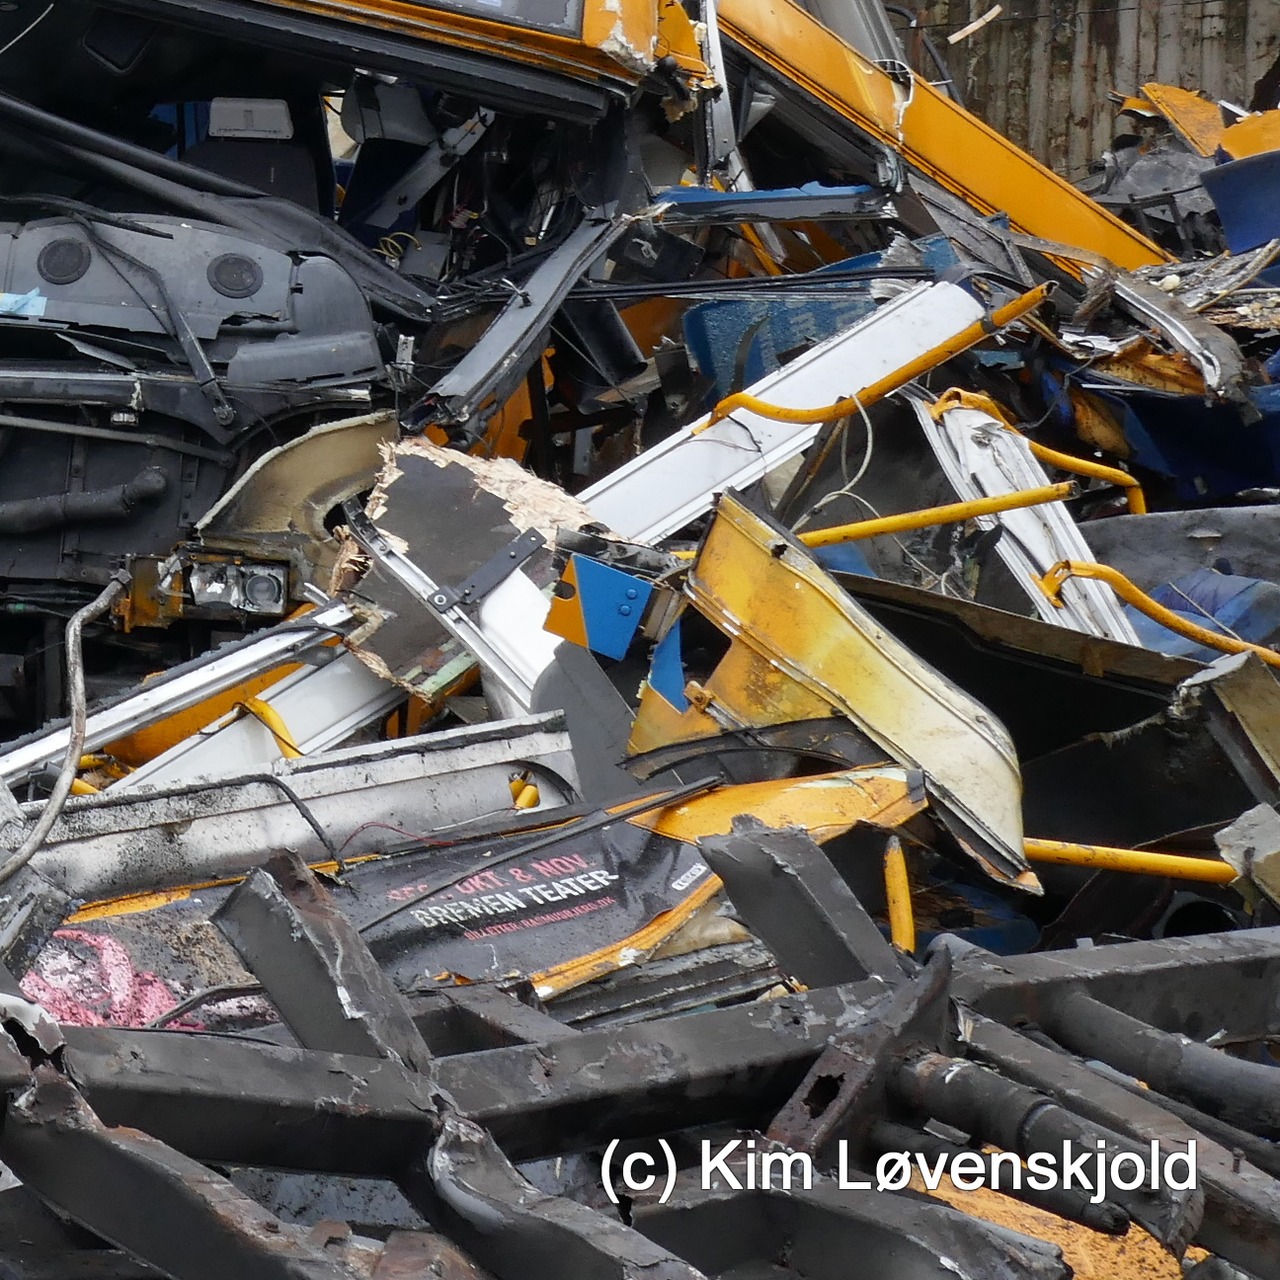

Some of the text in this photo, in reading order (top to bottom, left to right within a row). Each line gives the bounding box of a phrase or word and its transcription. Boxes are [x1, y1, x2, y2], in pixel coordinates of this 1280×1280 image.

[509, 868, 536, 884] &
[410, 870, 619, 928] BREMEN TEATER
